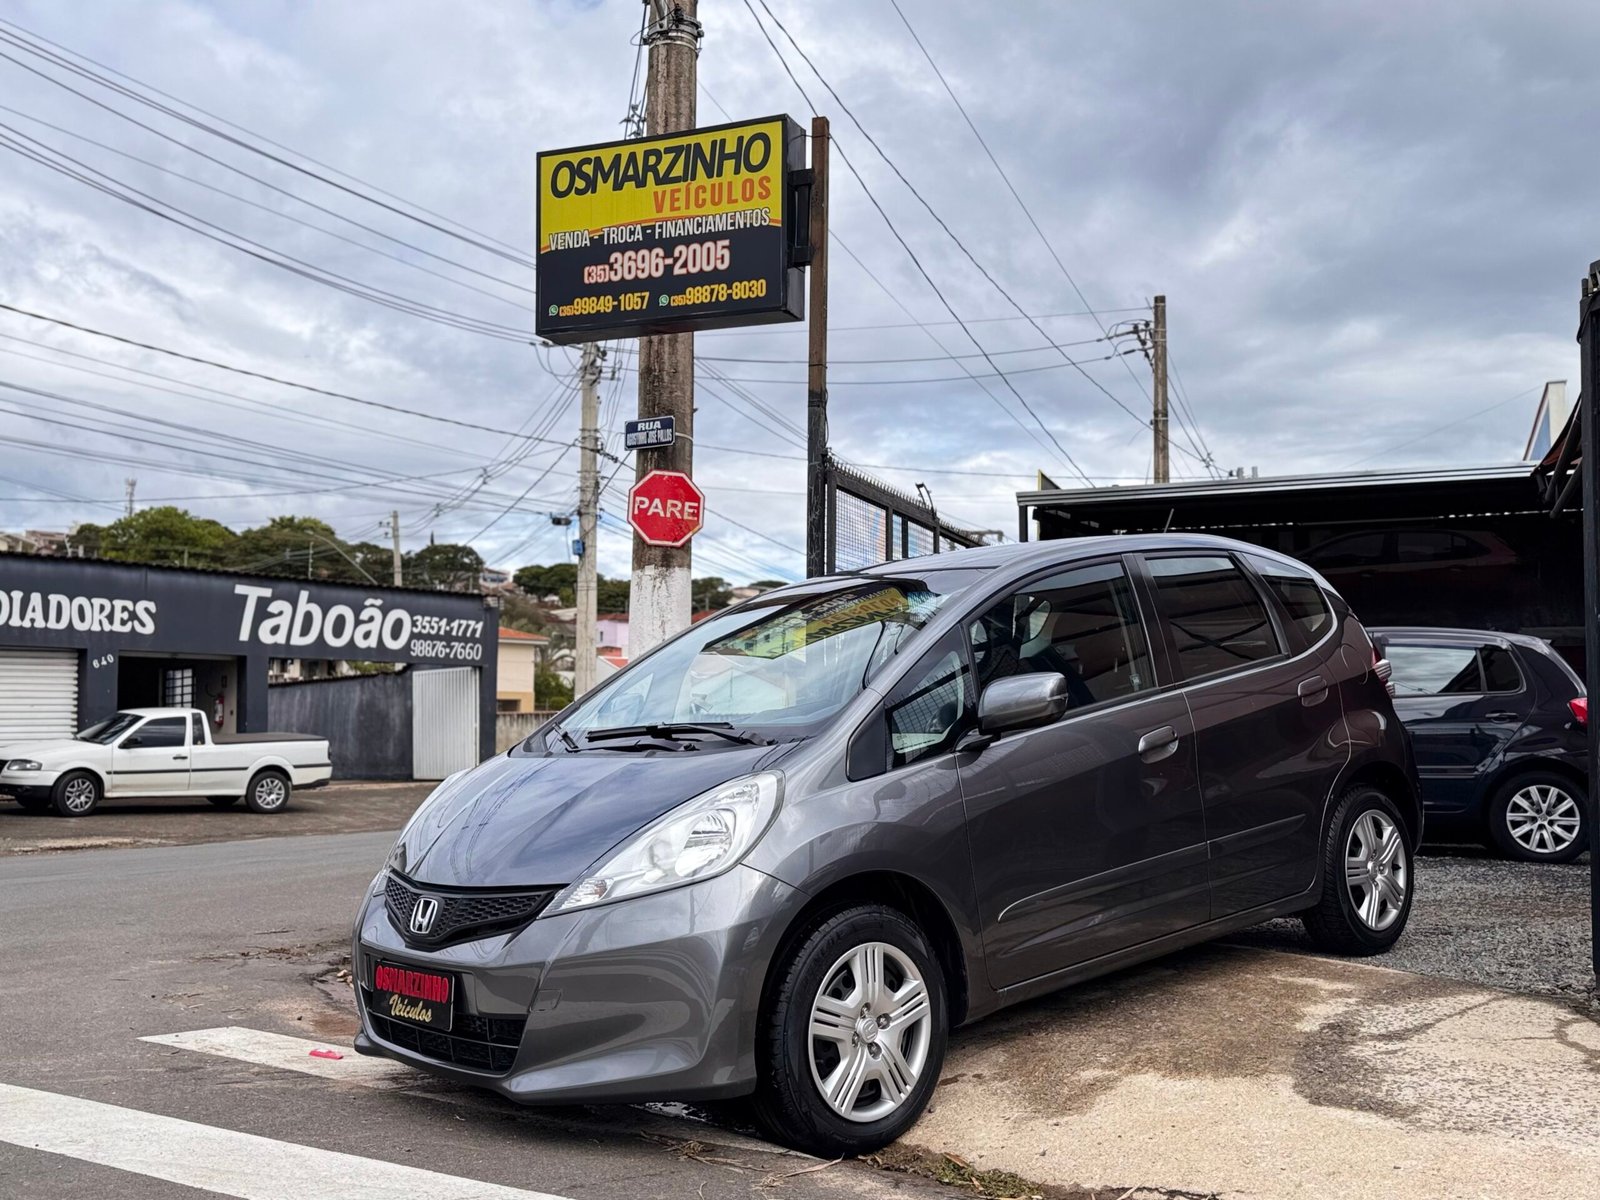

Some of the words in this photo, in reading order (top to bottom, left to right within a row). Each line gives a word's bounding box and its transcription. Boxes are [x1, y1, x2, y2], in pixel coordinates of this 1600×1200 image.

[551, 132, 771, 198] OSMARZINHO
[653, 176, 771, 213] VEÍCULOS
[549, 230, 590, 251] VENDA
[602, 224, 643, 245] TROCA
[655, 207, 770, 239] FINANCIAMENTOS
[637, 420, 661, 431] RUA
[634, 496, 699, 520] PARE
[234, 584, 412, 650] Taboão
[376, 964, 449, 1004] OSMARZINHO
